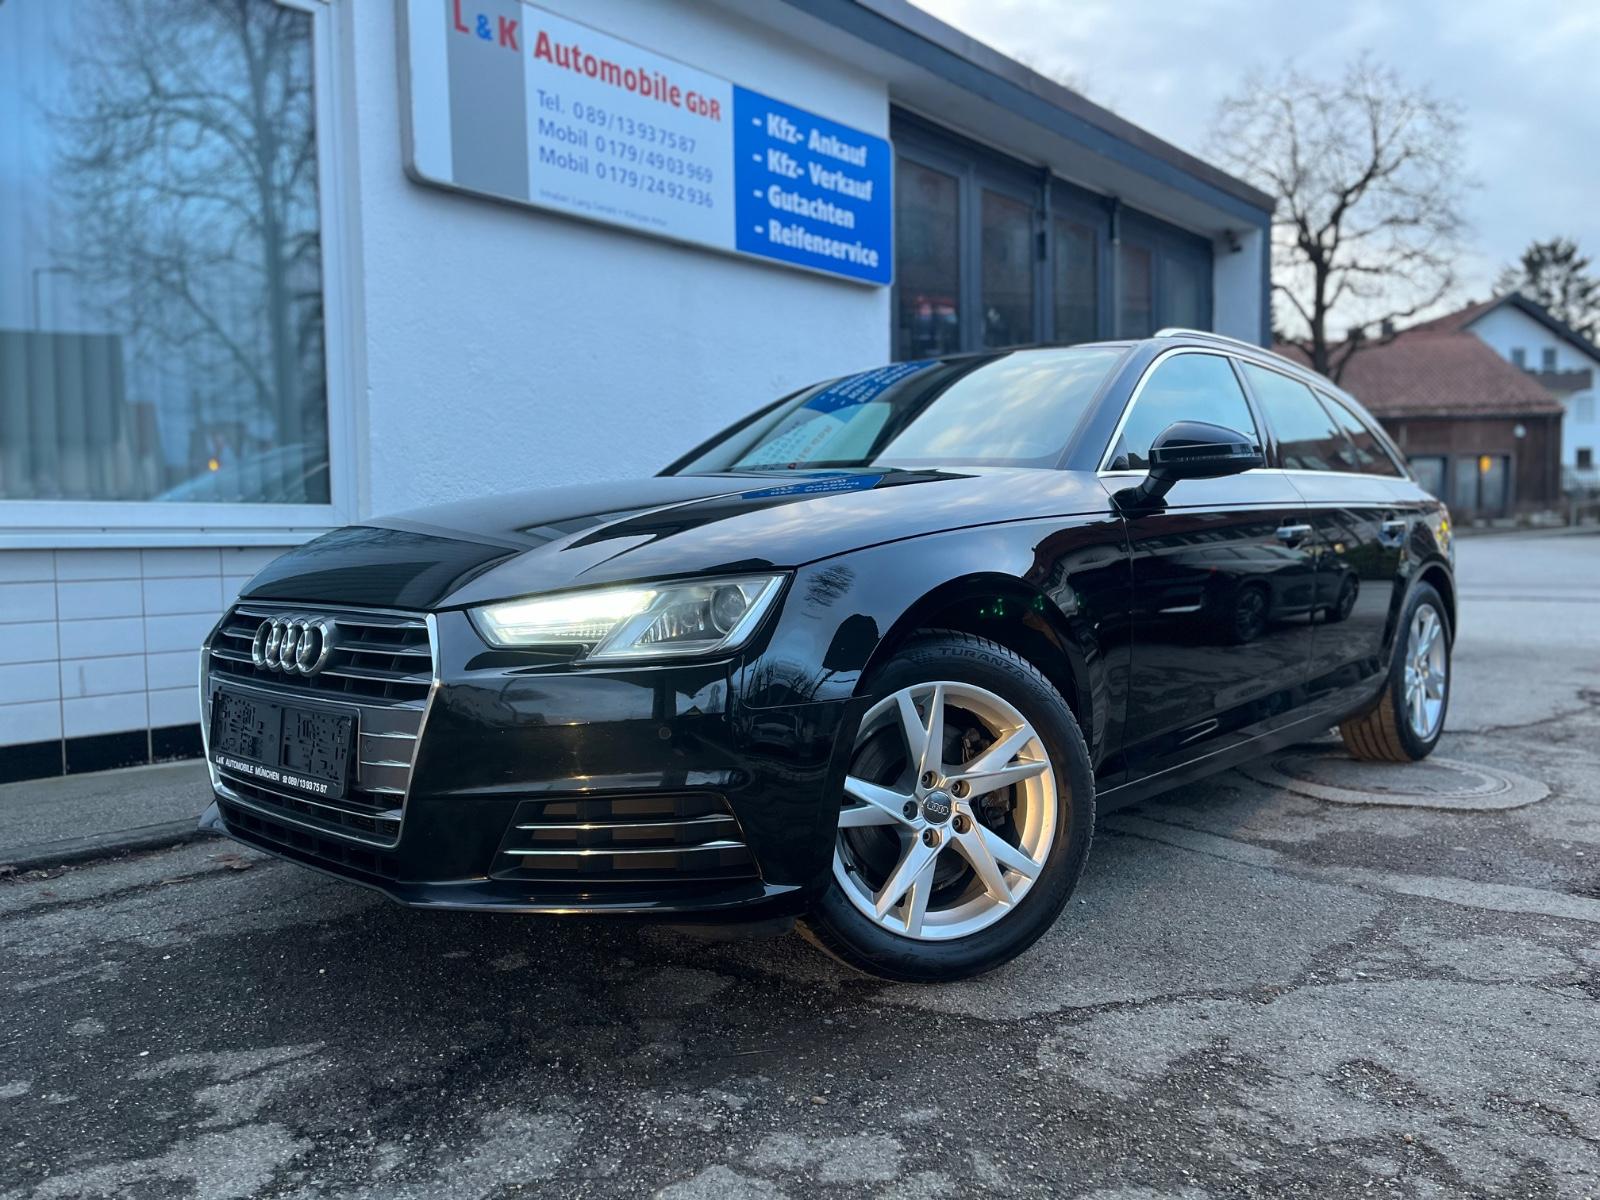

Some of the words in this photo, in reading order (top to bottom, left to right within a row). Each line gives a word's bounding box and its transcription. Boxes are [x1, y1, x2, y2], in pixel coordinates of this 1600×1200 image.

[453, 0, 470, 33] L
[476, 14, 493, 41] &
[498, 15, 519, 52] K
[533, 31, 681, 108] Automobile
[685, 91, 721, 122] GbR
[537, 89, 566, 114] Tel.
[538, 117, 588, 148] Mobil
[767, 112, 805, 144] Kfz-
[808, 128, 867, 167] Ankauf
[539, 146, 589, 175] Mobil
[767, 148, 805, 179] Kfz-
[808, 161, 873, 202] Verkauf
[767, 184, 855, 229] Gutachten
[768, 218, 879, 268] Reifenservice
[938, 647, 1025, 681] TURANZA
[226, 758, 254, 774] AUTOMOBILE
[255, 766, 280, 782] MÜNCHEN
